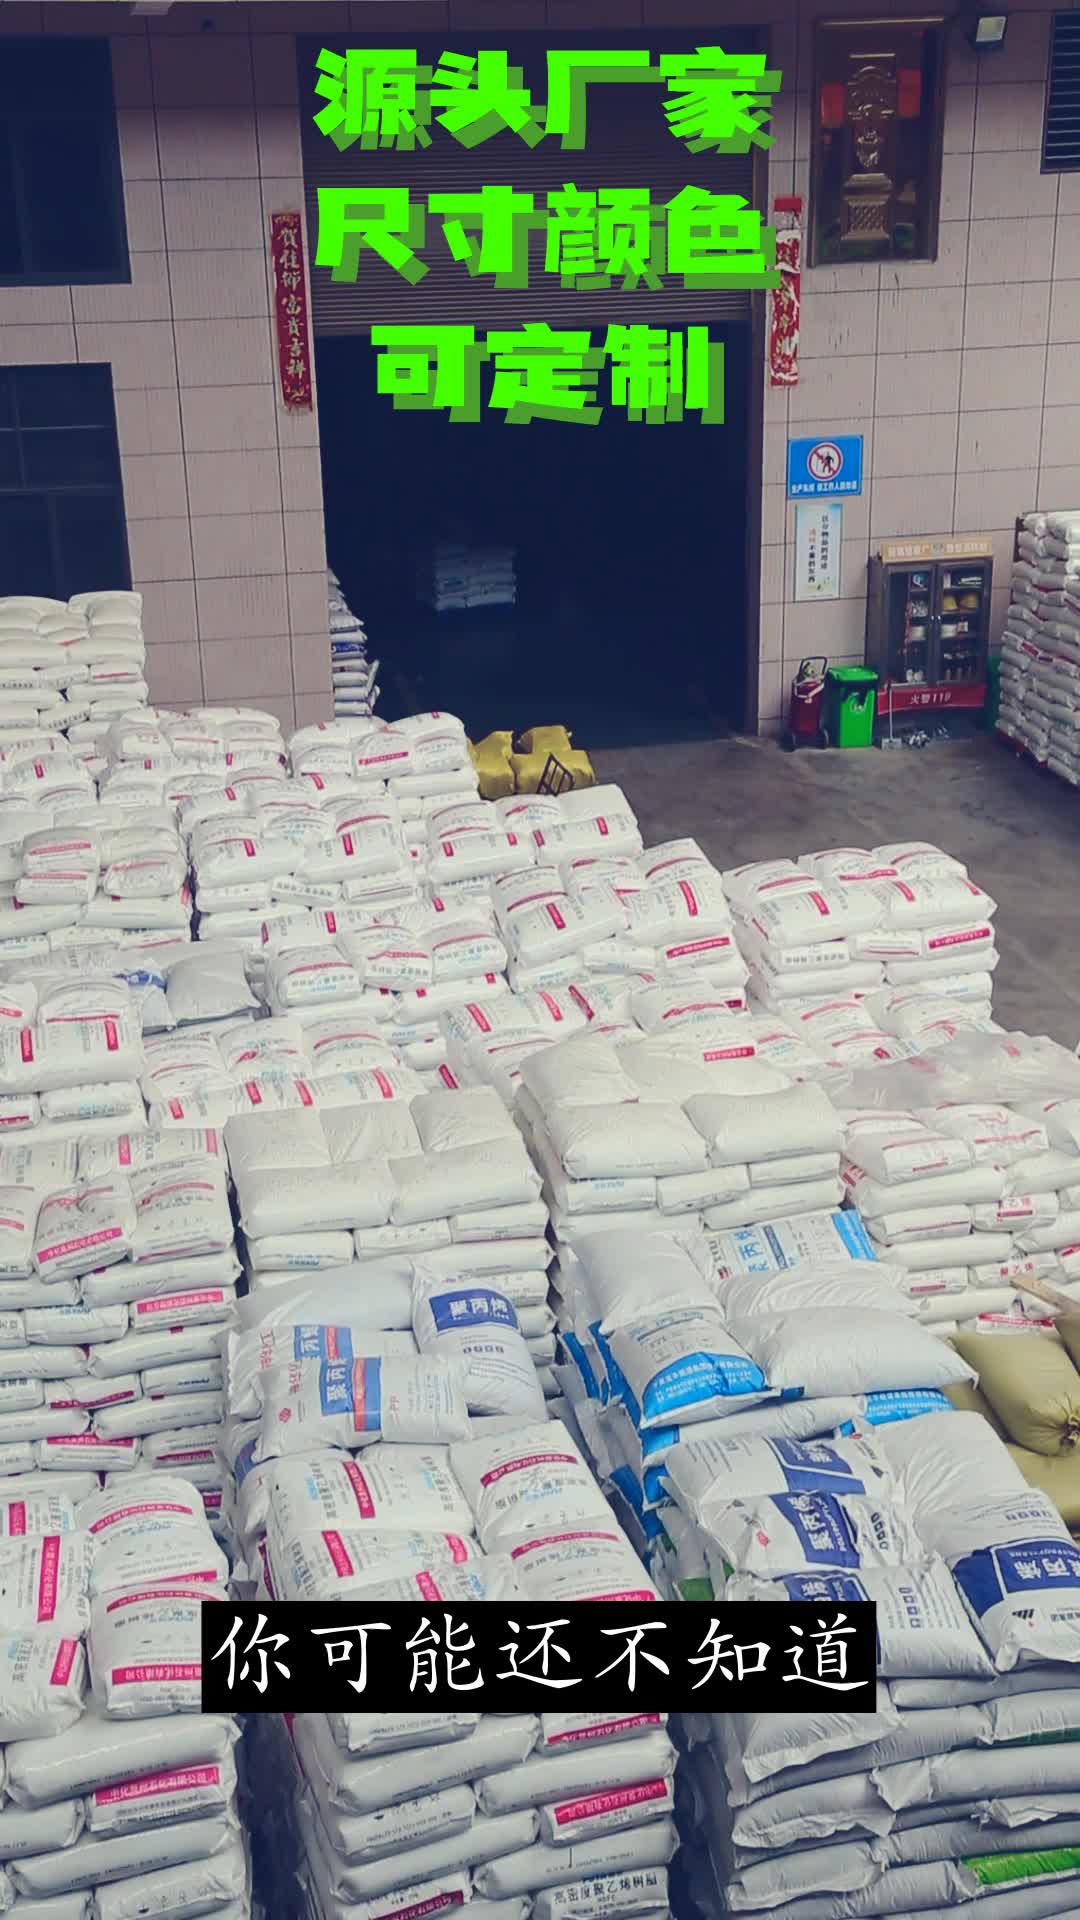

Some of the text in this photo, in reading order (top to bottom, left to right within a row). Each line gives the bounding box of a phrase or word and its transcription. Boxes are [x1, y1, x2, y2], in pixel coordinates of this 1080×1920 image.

[449, 1296, 508, 1317] 聚丙烯
[787, 1496, 834, 1551] 聚丙烯
